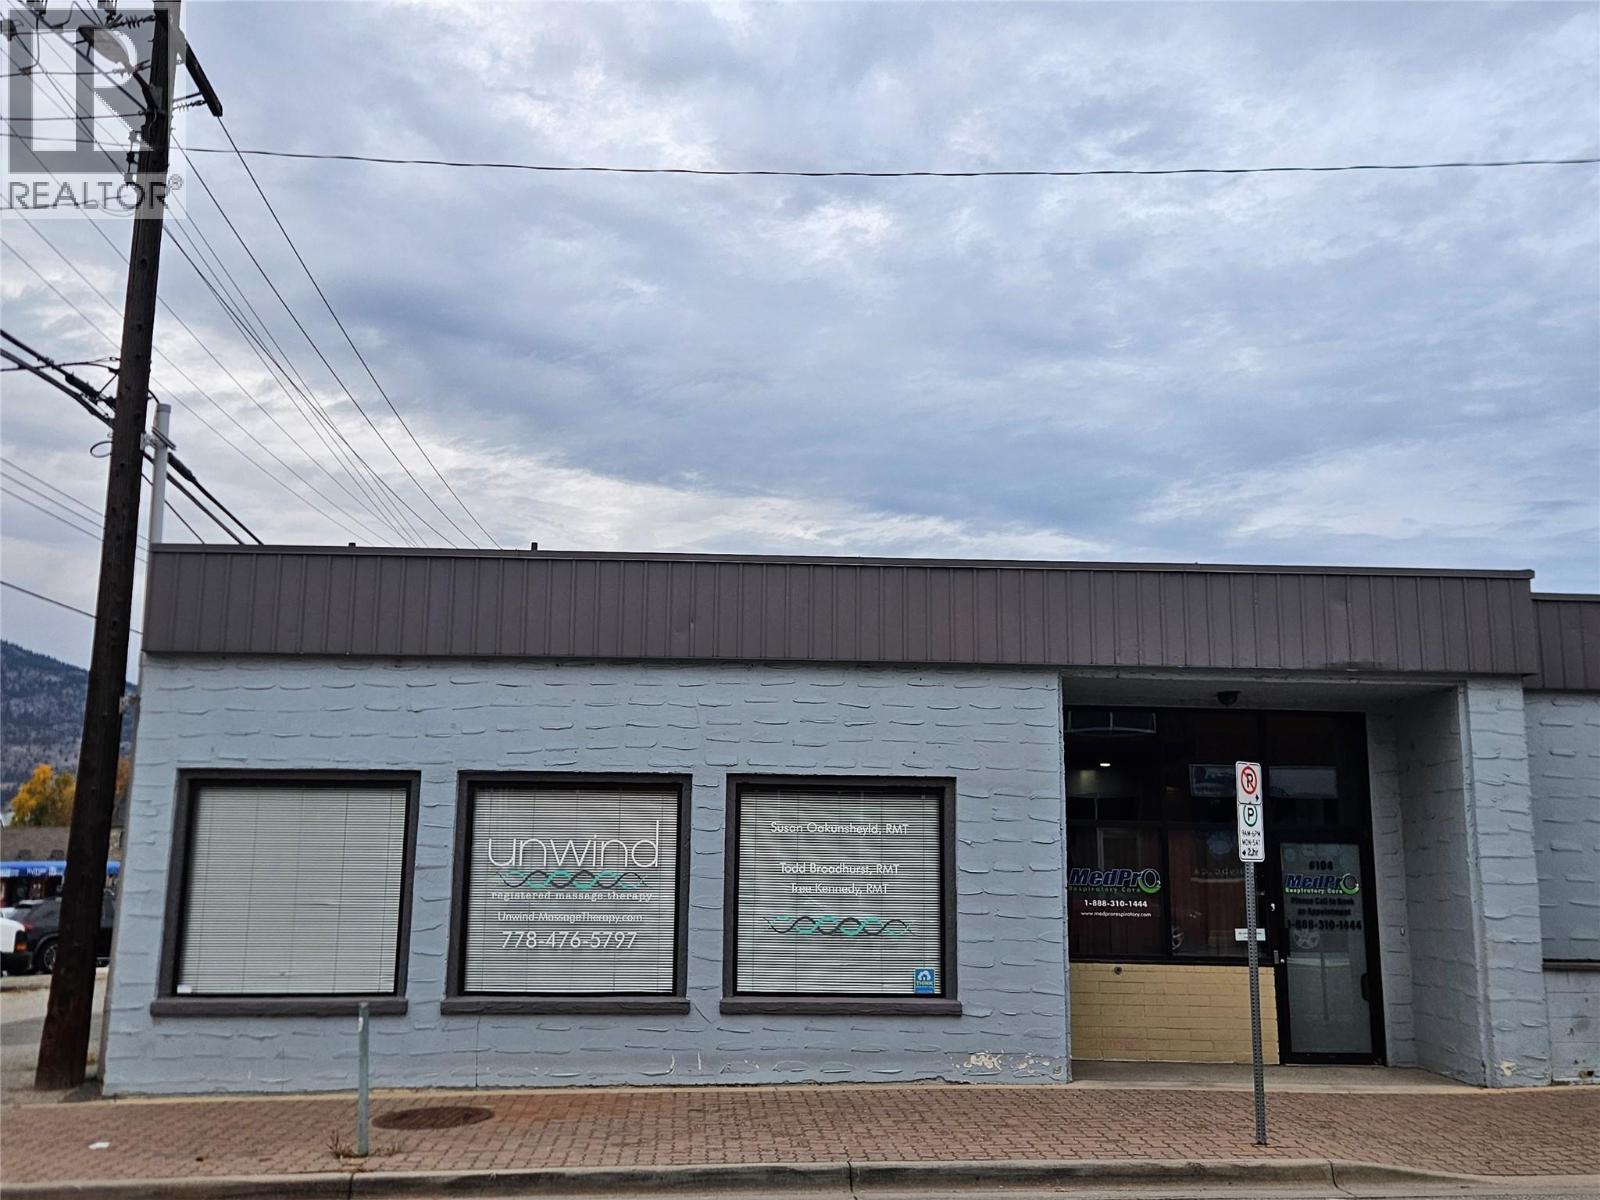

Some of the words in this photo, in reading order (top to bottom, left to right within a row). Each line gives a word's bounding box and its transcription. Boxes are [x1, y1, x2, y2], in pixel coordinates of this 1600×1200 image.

[770, 821, 802, 834] Susan
[885, 823, 910, 835] RMT
[488, 820, 660, 868] unwind
[780, 862, 806, 874] Todd
[810, 862, 873, 876] Broadhurst,
[876, 863, 900, 875] RMT
[815, 882, 863, 896] Kennedy,
[866, 883, 889, 895] RMT
[491, 891, 550, 902] registered
[555, 891, 603, 902] massage
[607, 891, 653, 902] therapy
[1084, 899, 1148, 907] 1-888-310-1444
[1287, 919, 1362, 931] 1-888-310-1444
[501, 930, 638, 949] 778-476-5797
